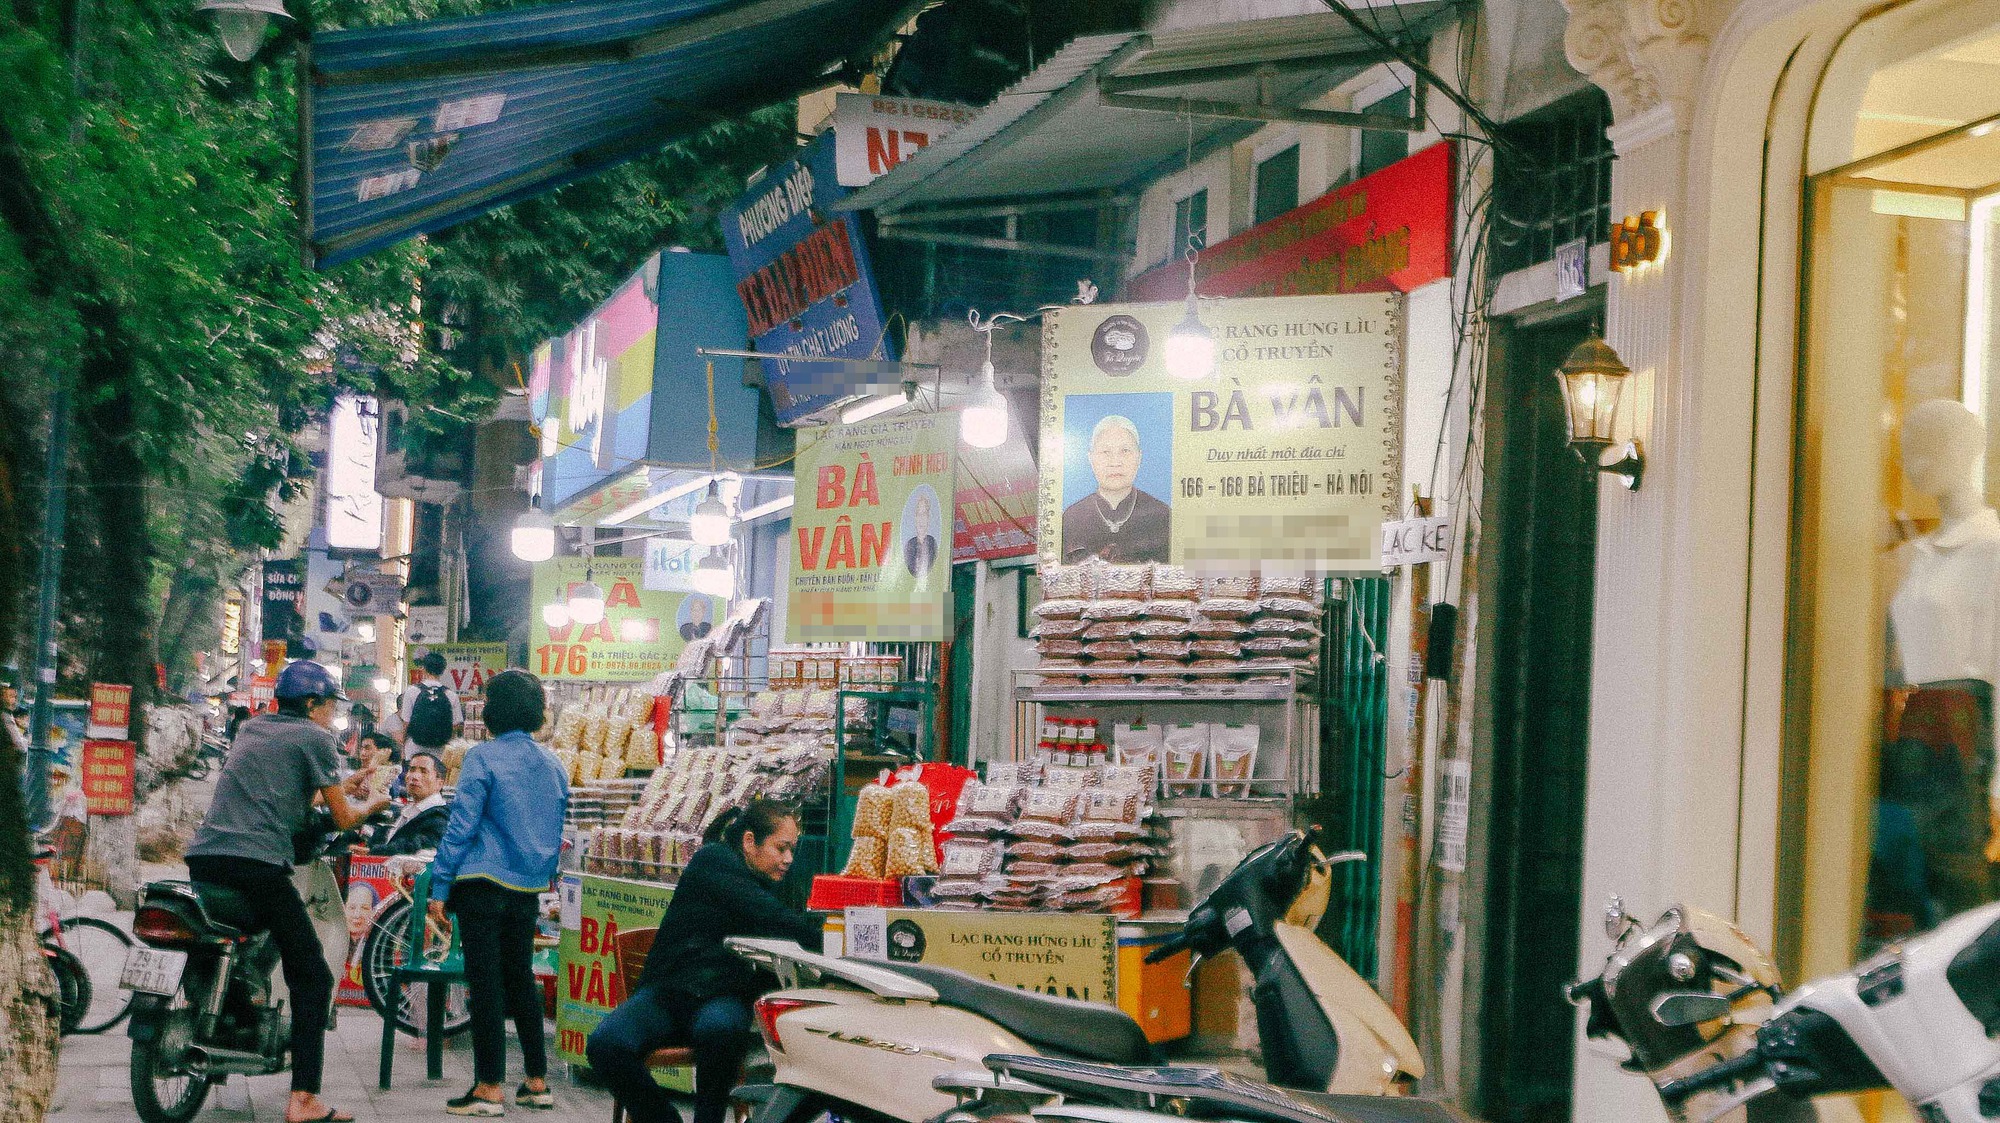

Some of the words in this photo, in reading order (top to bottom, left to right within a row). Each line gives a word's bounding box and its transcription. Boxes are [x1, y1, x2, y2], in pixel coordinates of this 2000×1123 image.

[1226, 323, 1278, 339] RANG
[1345, 316, 1377, 335] LÌU
[1254, 339, 1334, 361] TRUYỀN
[1191, 377, 1254, 432] BÀ
[1269, 374, 1366, 429] VÂN
[1207, 448, 1233, 462] Duy
[1236, 444, 1268, 460] nhất
[1271, 446, 1296, 460] một
[816, 451, 880, 511] BÀ
[1181, 476, 1204, 498] 166
[1248, 471, 1266, 497] BÀ
[1271, 470, 1309, 500] TRIỆU
[1327, 469, 1344, 495] HÀ
[1350, 469, 1374, 499] NỘI
[797, 515, 893, 571] VÂN
[537, 644, 588, 676] 176
[360, 863, 385, 878] RANG
[580, 913, 618, 957] BÀ
[950, 933, 980, 946] LẠC
[983, 933, 1023, 946] RANG
[1073, 935, 1097, 948] LÌU
[561, 1029, 585, 1056] 170
